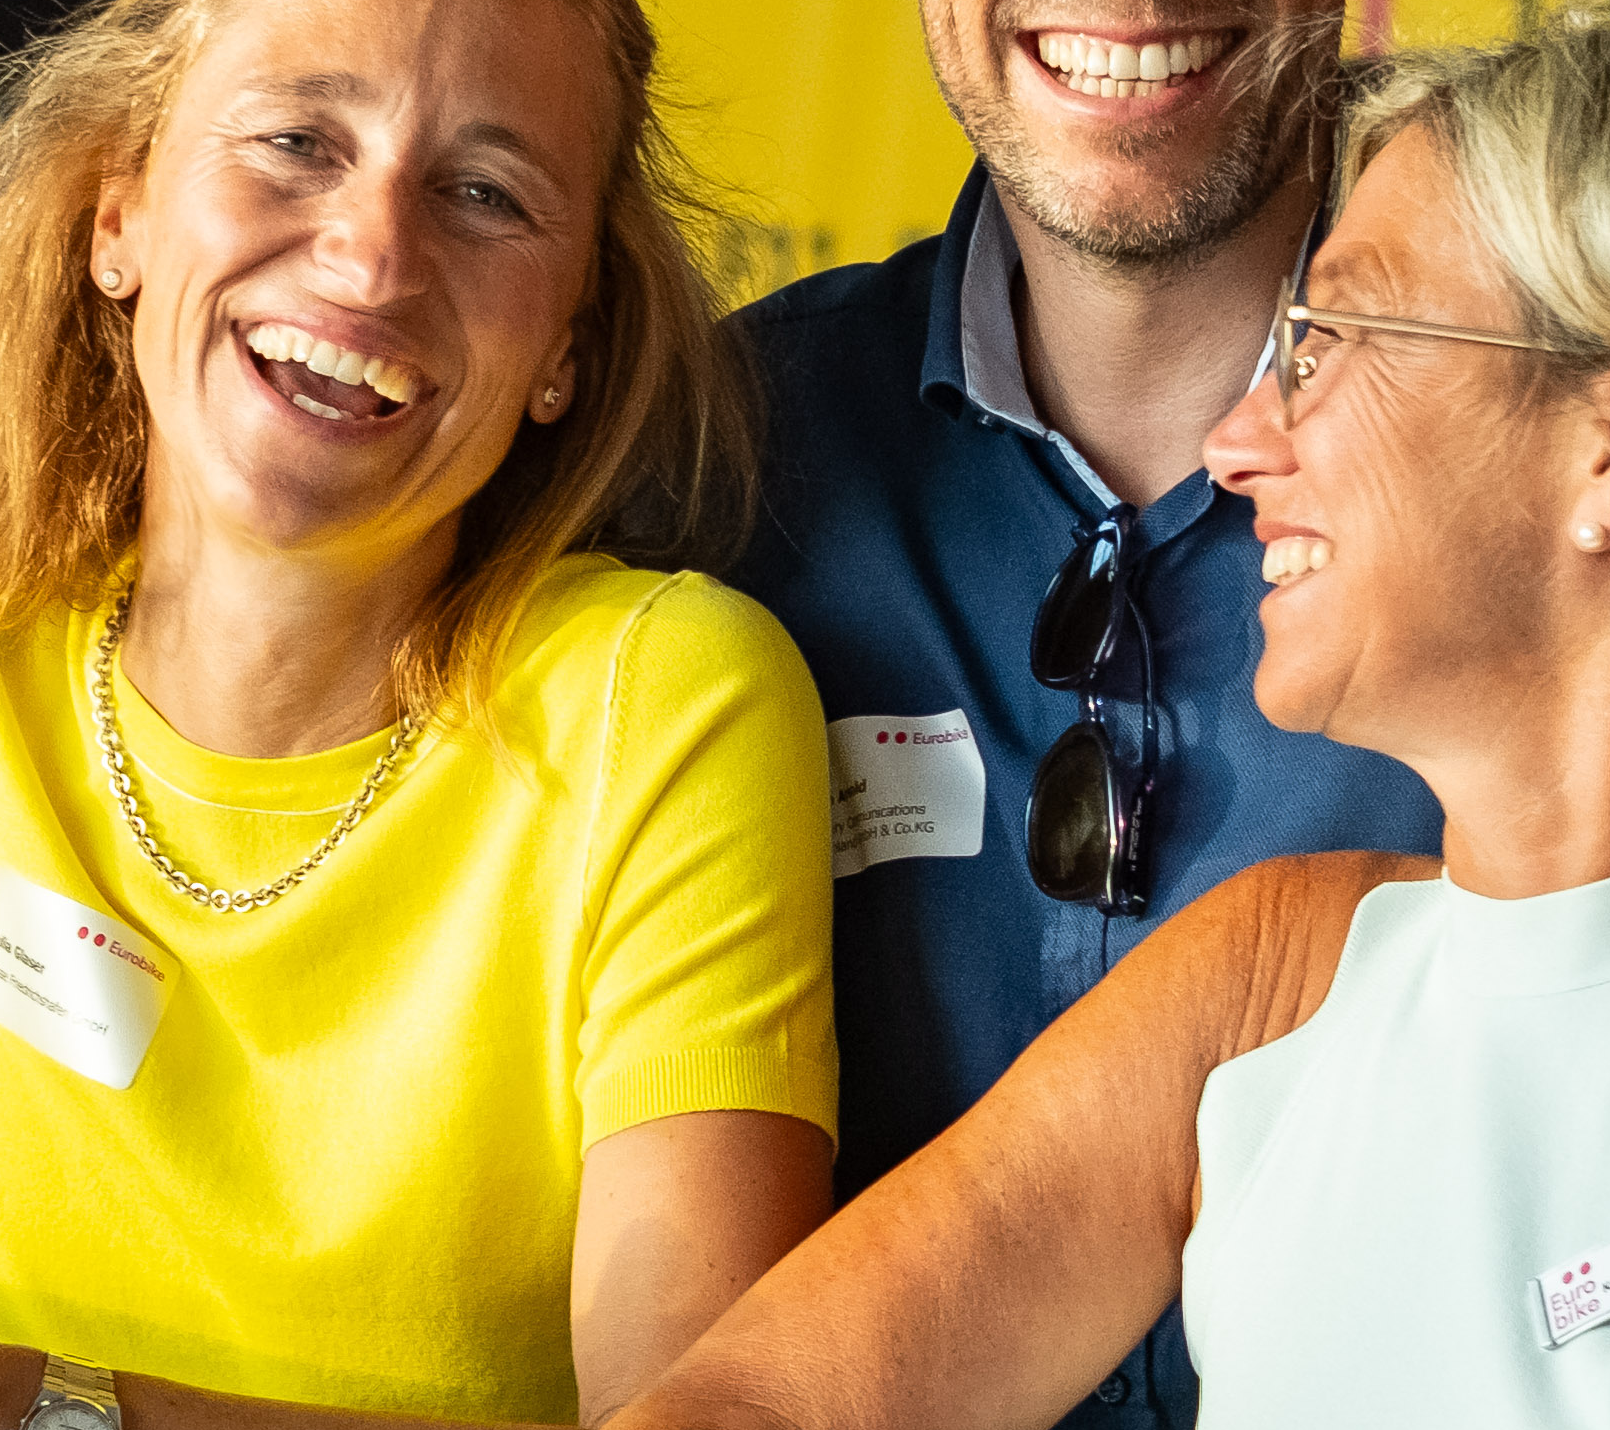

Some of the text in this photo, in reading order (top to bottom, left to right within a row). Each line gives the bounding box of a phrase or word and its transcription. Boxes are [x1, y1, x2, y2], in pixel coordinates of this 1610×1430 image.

[912, 727, 970, 746] Eurobike
[108, 939, 166, 983] Eurobike
[1550, 1279, 1597, 1313] Euro
[1553, 1297, 1601, 1331] bike
